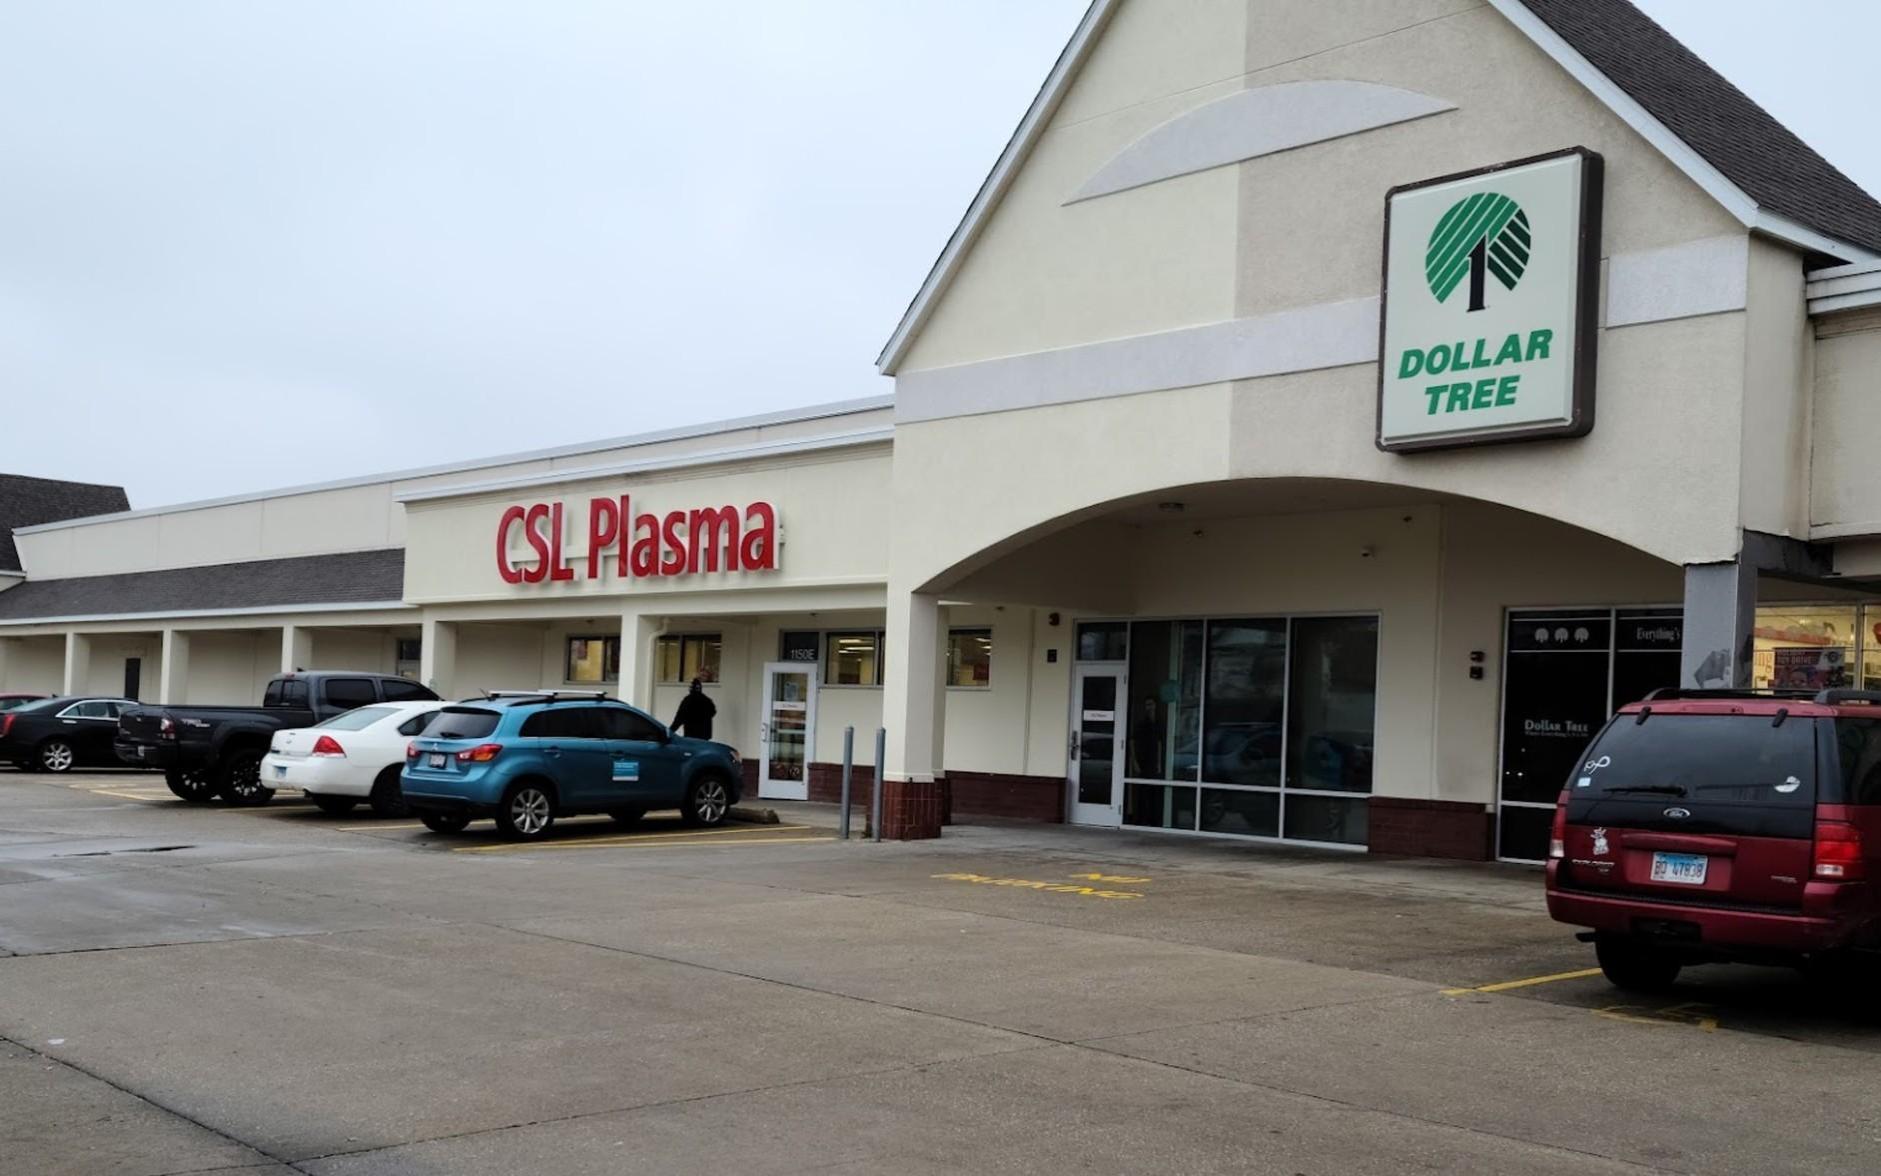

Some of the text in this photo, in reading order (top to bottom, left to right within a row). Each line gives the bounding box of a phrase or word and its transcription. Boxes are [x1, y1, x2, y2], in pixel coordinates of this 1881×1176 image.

[1397, 329, 1553, 379] DOLLAR
[1424, 375, 1521, 415] TREE
[496, 494, 775, 584] CSL Plasma
[789, 647, 815, 660] 1150E
